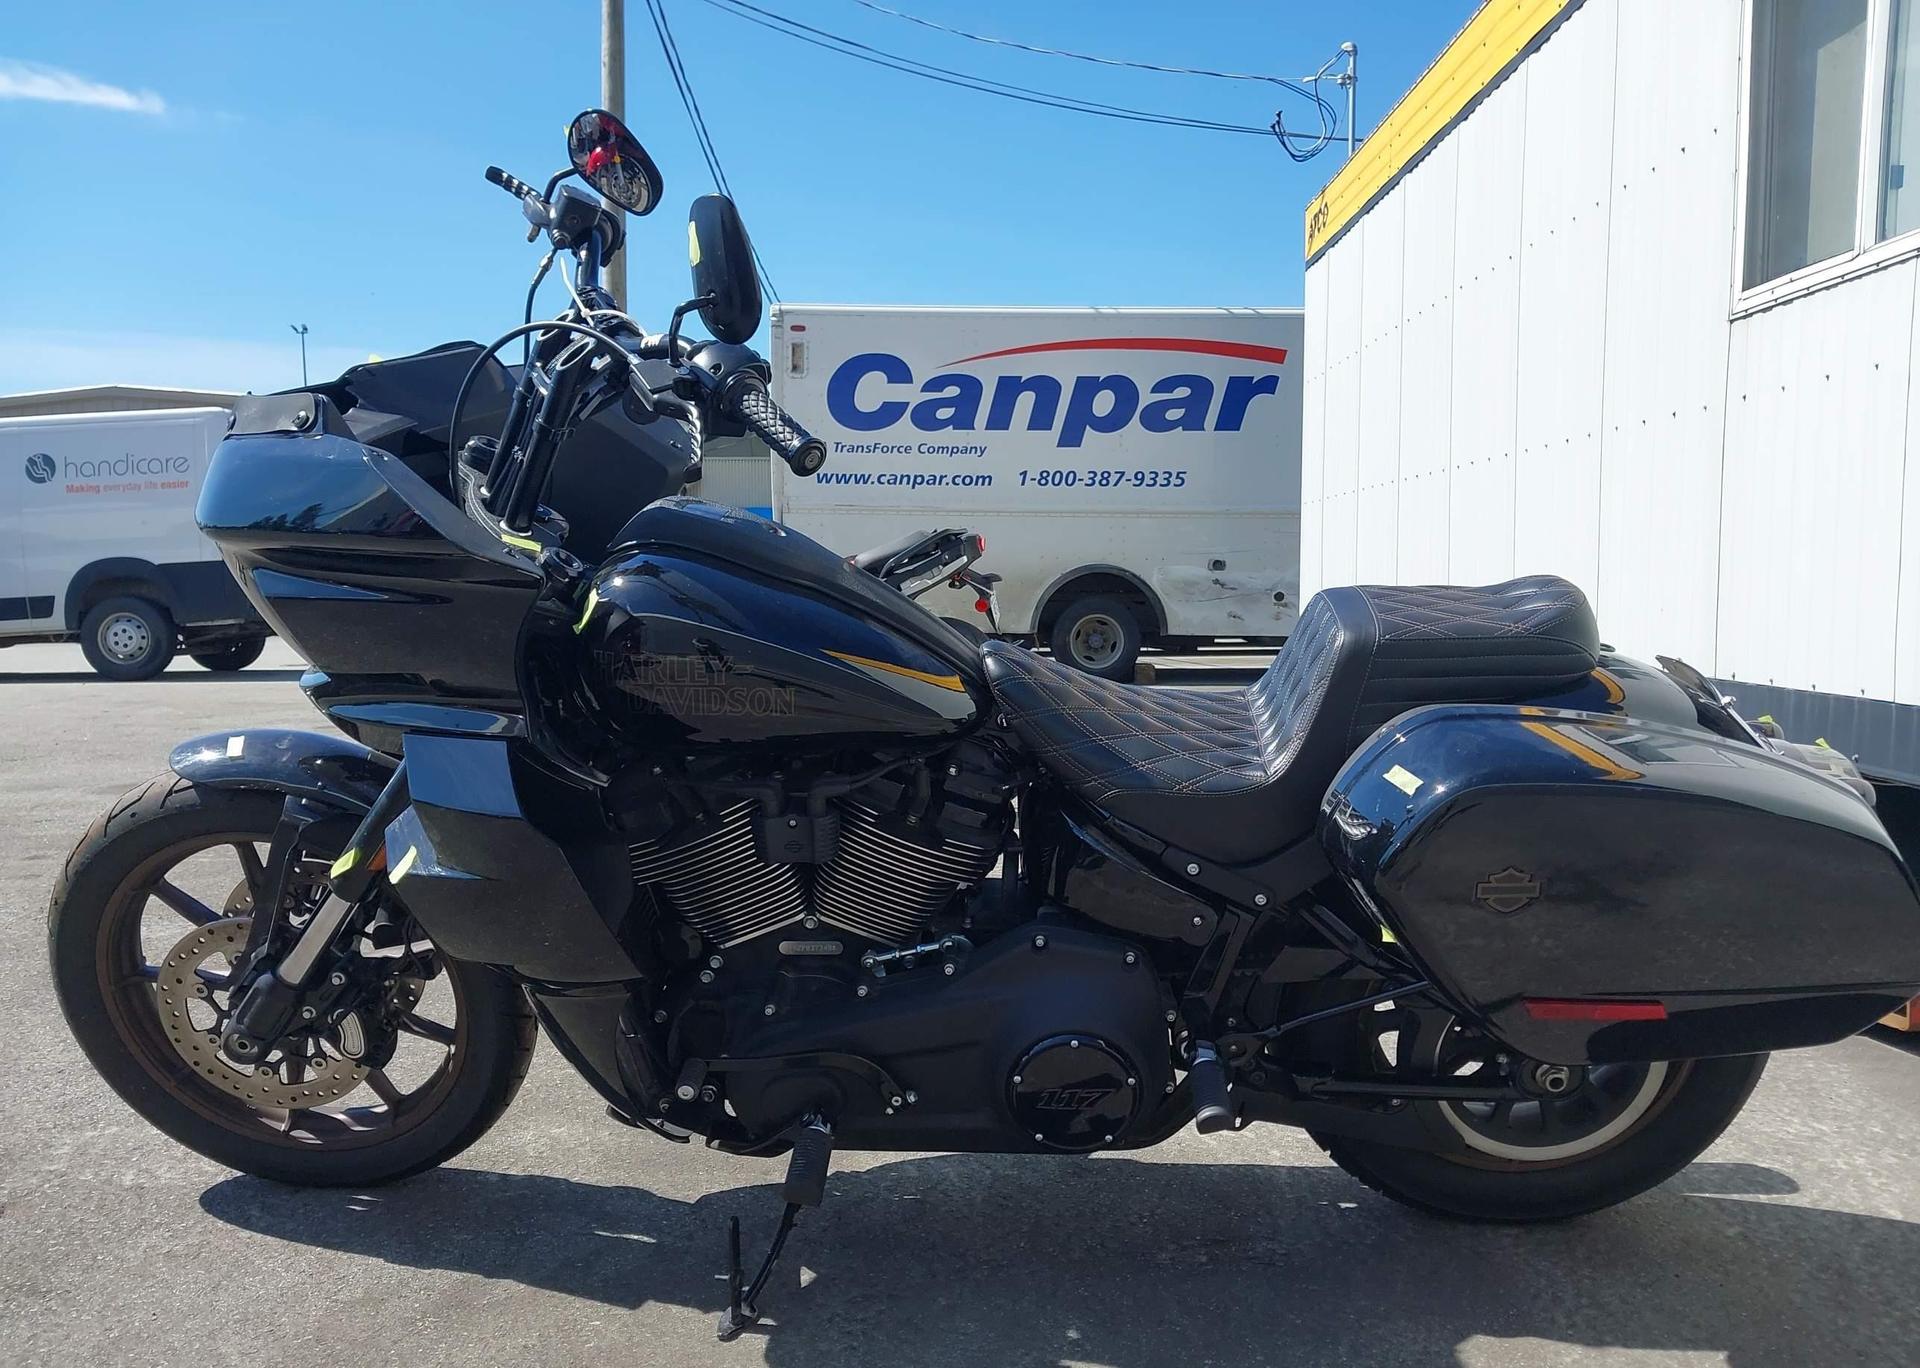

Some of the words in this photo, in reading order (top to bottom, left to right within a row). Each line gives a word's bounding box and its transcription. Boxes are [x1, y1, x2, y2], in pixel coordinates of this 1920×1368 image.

[826, 352, 1280, 448] Canpar
[833, 441, 913, 455] TransForce
[917, 442, 988, 458] Company
[64, 452, 190, 479] handicare
[65, 484, 100, 495] Making
[103, 482, 142, 493] everyday
[144, 481, 158, 491] life
[160, 479, 190, 490] easier
[816, 471, 993, 490] www.canpar.com
[1018, 469, 1188, 488] 1-800-387-9335
[626, 686, 798, 717] DAVIDSON
[1035, 1088, 1114, 1111] 117
